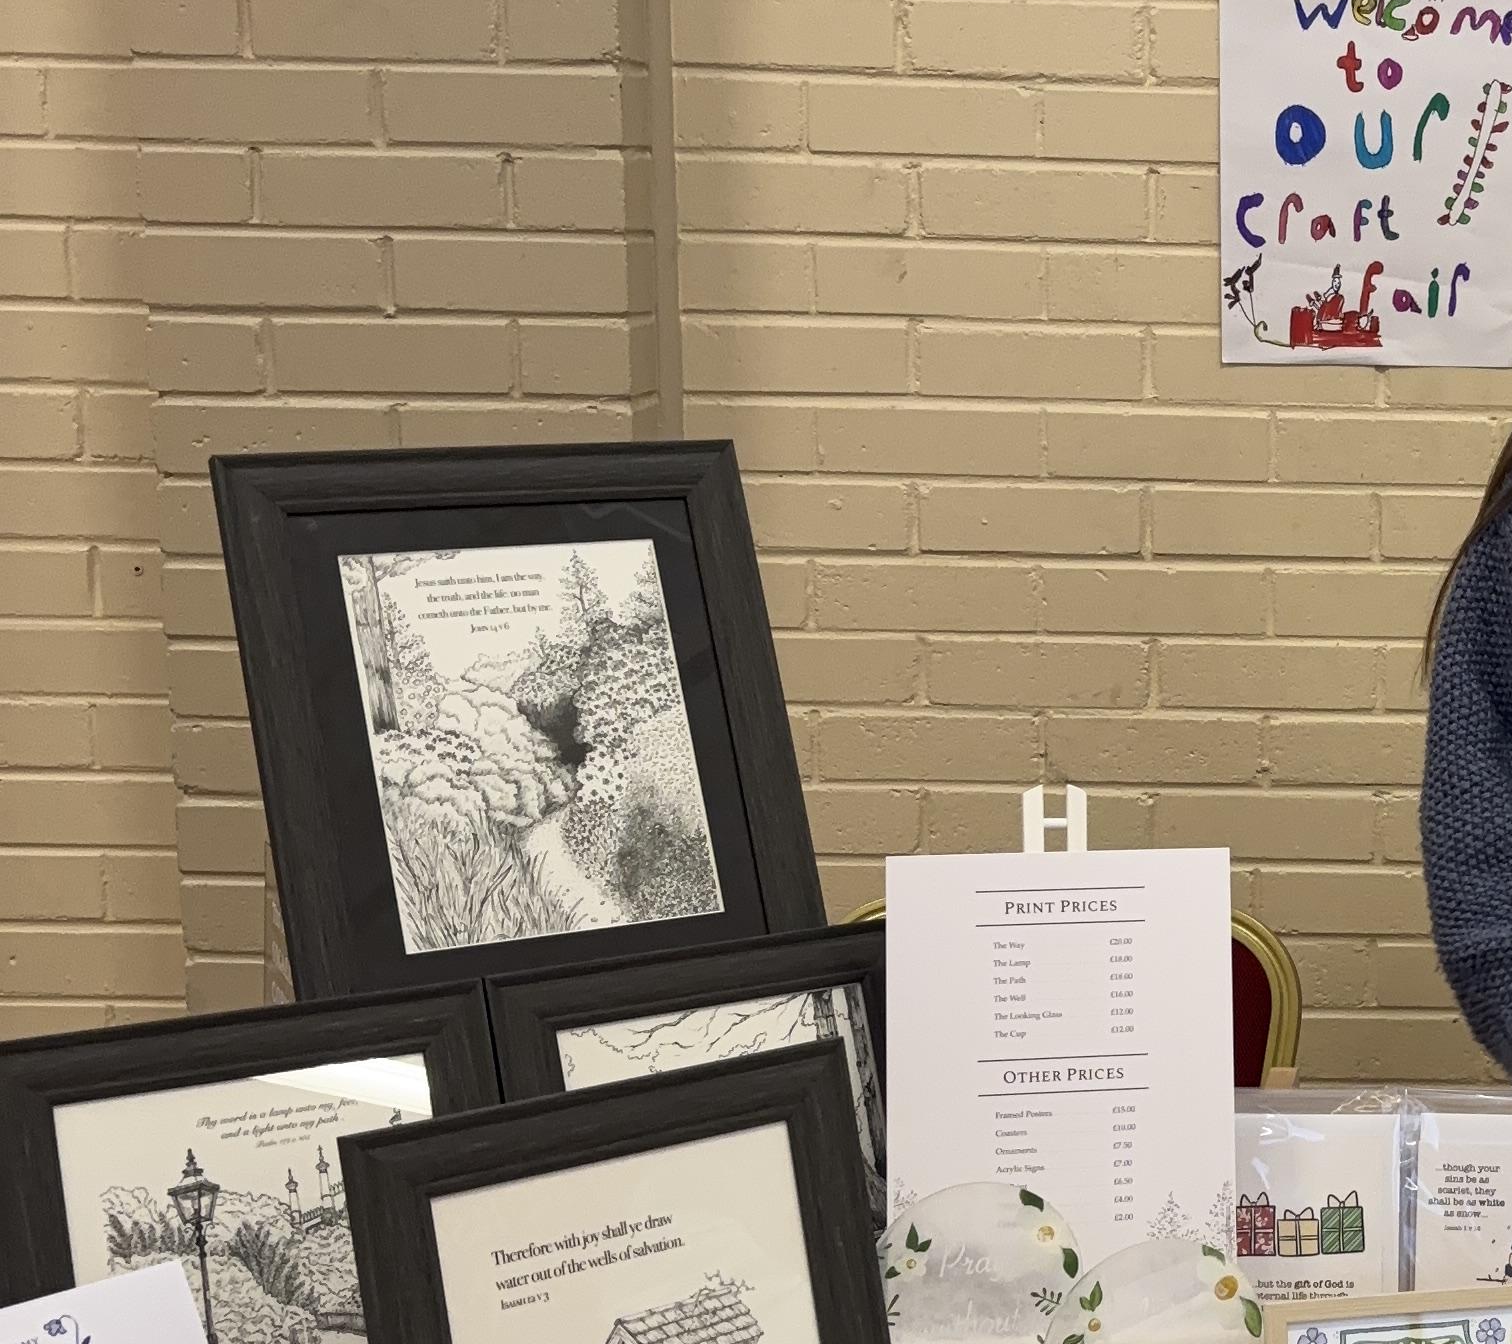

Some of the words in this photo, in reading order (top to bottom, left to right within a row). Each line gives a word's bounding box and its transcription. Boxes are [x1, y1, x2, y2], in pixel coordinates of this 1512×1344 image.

[1336, 40, 1403, 93] to
[1358, 261, 1470, 318] fair
[1005, 901, 1055, 915] PRINT
[1060, 899, 1118, 913] PRICES
[1003, 1070, 1062, 1084] OTHER
[1067, 1067, 1125, 1081] PRICES
[1477, 1165, 1501, 1174] your
[1444, 1175, 1464, 1184] sins
[1465, 1175, 1477, 1184] be
[1478, 1176, 1490, 1184] as
[1474, 1186, 1497, 1197] they
[1428, 1197, 1451, 1206] shall
[1453, 1197, 1464, 1206] be
[1478, 1198, 1506, 1207] white
[491, 1242, 553, 1267] Therefore
[554, 1233, 581, 1253] with
[581, 1229, 601, 1251] joy
[601, 1220, 628, 1241] shall
[628, 1221, 643, 1239] ye
[644, 1213, 674, 1230] draw
[495, 1273, 530, 1293] water
[531, 1265, 552, 1283] out
[553, 1262, 568, 1278] of
[567, 1258, 588, 1276] the
[588, 1250, 618, 1270] wells
[618, 1245, 634, 1263] of
[1275, 1280, 1293, 1288] the
[1294, 1280, 1311, 1290] gift
[1312, 1280, 1323, 1289] of
[1324, 1280, 1344, 1289] God
[1345, 1280, 1355, 1289] is
